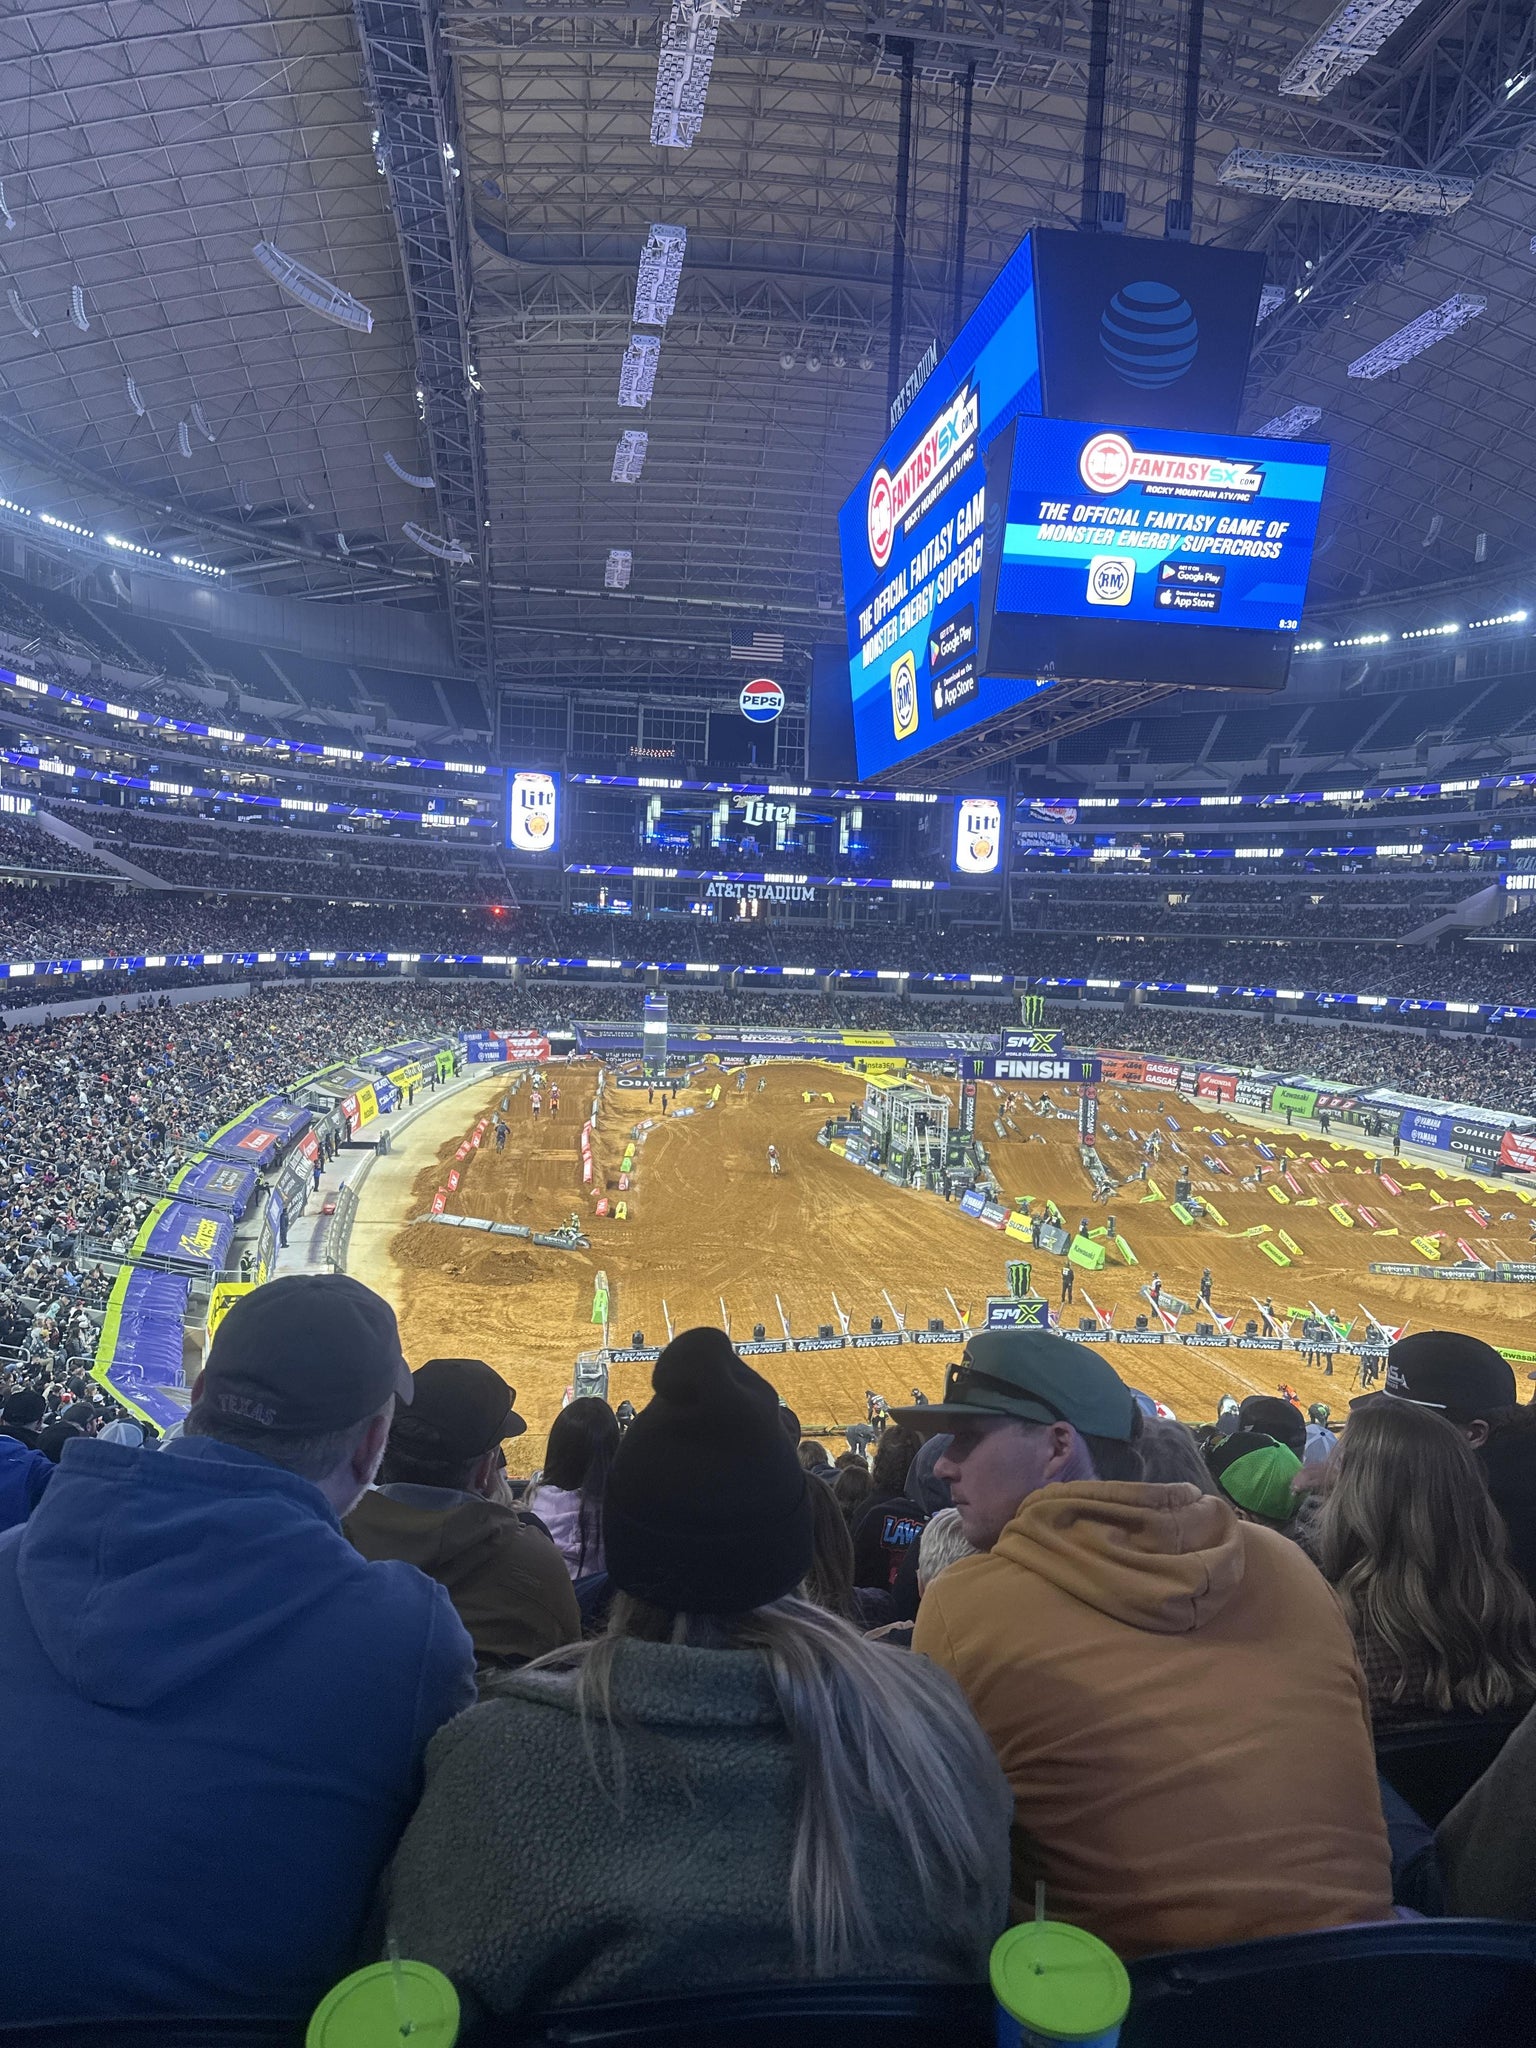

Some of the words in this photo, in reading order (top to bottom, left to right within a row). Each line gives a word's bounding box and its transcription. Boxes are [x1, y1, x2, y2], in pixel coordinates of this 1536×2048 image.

[890, 389, 906, 431] AT&T
[906, 339, 938, 407] STADIUM
[920, 473, 950, 514] MOUNTAIN
[1146, 485, 1174, 495] ROCKY
[1174, 488, 1218, 500] MOUNTAIN
[1217, 492, 1251, 502] ATV/MC
[1038, 501, 1067, 521] THE
[1072, 504, 1140, 528] OFFICIAL
[1144, 510, 1216, 533] FANTASY
[1216, 516, 1265, 538] GAME
[1265, 521, 1290, 539] OF
[1036, 523, 1116, 546] MONSTER
[1117, 531, 1182, 552] ENERGY
[1181, 535, 1283, 560] SUPERCROSS
[858, 604, 874, 640] THE
[874, 574, 909, 626] OFFICIAL
[910, 518, 955, 591] FANTASY
[957, 486, 985, 546] GAM
[1100, 573, 1122, 588] RM
[1177, 571, 1204, 583] Google
[1204, 573, 1220, 585] Play
[862, 614, 898, 670] MONSTER
[900, 585, 934, 637] ENERGY
[937, 533, 984, 605] SUPERC
[1173, 598, 1192, 609] App
[1192, 598, 1215, 609] Store
[1279, 619, 1298, 630] 8:30
[940, 634, 961, 657] Google
[959, 626, 971, 646] Play
[945, 686, 958, 705] App
[957, 677, 974, 700] Store
[742, 695, 782, 707] PEPSI
[456, 815, 470, 826] LAP
[742, 801, 791, 827] Lite
[1127, 848, 1141, 858] LAP
[922, 881, 935, 890] LAP
[1506, 875, 1536, 890] SIGHTI
[705, 881, 745, 898] AT&T
[747, 884, 816, 902] STADIUM
[1006, 1033, 1057, 1052] SMX
[995, 1060, 1070, 1079] FINISH
[1146, 1063, 1179, 1075] GASGAS
[1145, 1074, 1177, 1087] GASGAS
[1209, 1078, 1232, 1087] HONDA
[1207, 1089, 1230, 1100] HODA
[1280, 1090, 1309, 1101] Kawasaki
[1420, 1117, 1442, 1129] YAMAHA
[1417, 1130, 1438, 1143] YAMAHA
[1465, 1128, 1503, 1142] OAKLEY
[1462, 1143, 1501, 1157] OAKLEY
[1073, 1244, 1096, 1260] Kawasaki
[1414, 1238, 1436, 1256] SUZUKI
[1382, 1266, 1411, 1274] MONSTER
[1441, 1271, 1475, 1279] MONSTER
[990, 1304, 1043, 1324] SMX
[1499, 1350, 1536, 1362] Kawasak
[218, 1393, 277, 1426] TEXAS
